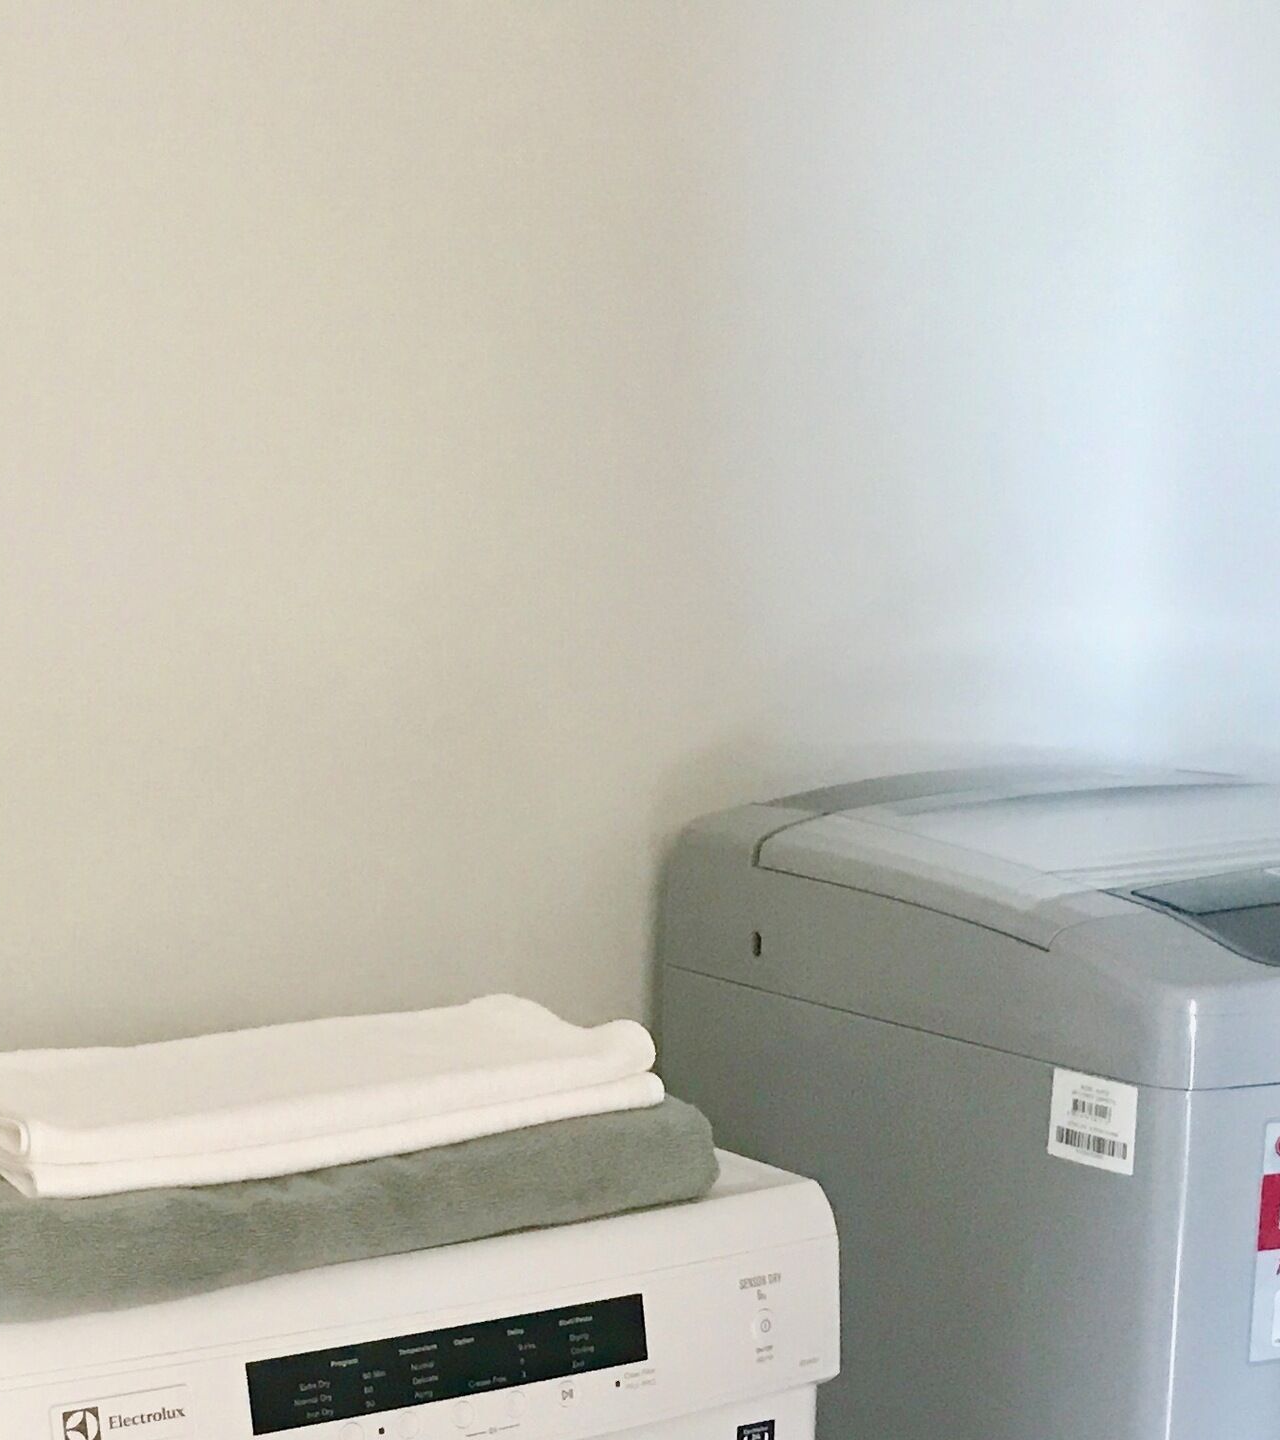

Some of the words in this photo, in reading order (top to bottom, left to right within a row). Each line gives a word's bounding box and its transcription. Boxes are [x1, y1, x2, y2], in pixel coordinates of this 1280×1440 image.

[738, 1274, 767, 1290] SENSOR
[767, 1272, 782, 1285] DRY
[330, 1357, 360, 1369] Program
[318, 1380, 331, 1390] Dry
[319, 1393, 333, 1403] Dry
[108, 1406, 186, 1430] Electrolux
[321, 1408, 335, 1418] Dry
